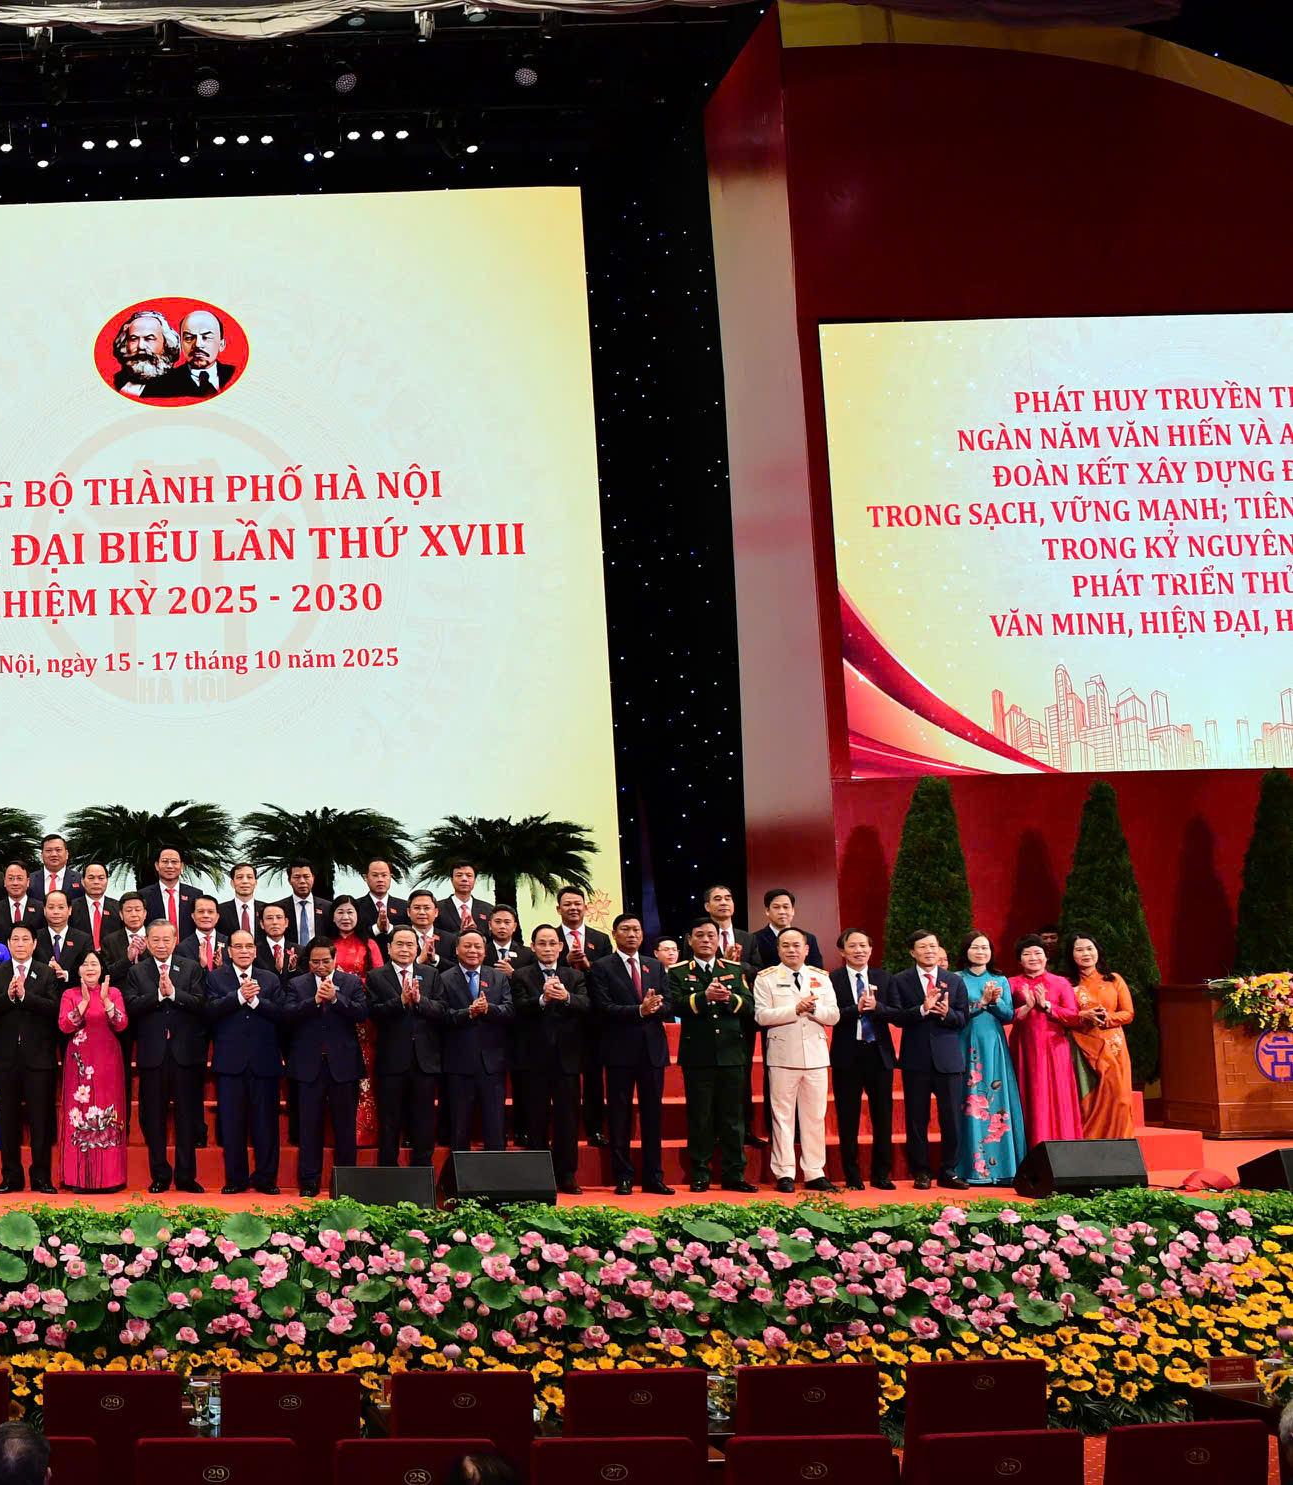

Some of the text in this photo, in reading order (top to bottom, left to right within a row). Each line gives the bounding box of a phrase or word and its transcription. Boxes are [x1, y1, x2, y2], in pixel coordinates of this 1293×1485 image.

[1015, 386, 1084, 413] PHÁT
[1094, 390, 1147, 411] HUY
[1155, 381, 1261, 410] TRUYỀN
[958, 423, 1031, 451] NGÀN
[1041, 423, 1099, 448] NĂM
[1108, 422, 1159, 447] VĂN
[1168, 418, 1231, 446] HIẾN
[1240, 418, 1272, 444] VÀ
[994, 459, 1068, 487] ĐOÀN
[1078, 457, 1128, 485] KẾT
[1138, 457, 1186, 484] XÂY
[1196, 461, 1274, 488] DỰNG
[25, 472, 73, 514] BỘ
[84, 469, 213, 505] THÀNH
[227, 465, 302, 502] PHỐ
[315, 465, 365, 500] HÀ
[378, 464, 441, 505] NỘI
[866, 491, 1293, 530] TRONG SẠCH, VỮNG MẠNH; TIÊN
[12, 533, 84, 574] ĐẠI
[100, 520, 197, 564] BIỂU
[213, 518, 295, 561] LẦN
[309, 517, 408, 559] THỨ
[421, 523, 525, 557] XVIII
[1042, 529, 1293, 560] TRONG KỶ NGUYÊN
[110, 579, 157, 615] KỲ
[168, 585, 257, 614] 2025
[292, 583, 382, 612] 2030
[1073, 569, 1144, 597] PHÁT
[1152, 568, 1234, 595] TRIỂN
[990, 609, 1042, 637] VĂN
[1052, 612, 1133, 637] MINH,
[1141, 606, 1205, 638] HIỆN
[1215, 610, 1268, 637] ĐẠI,
[0, 654, 40, 678] Nội,
[48, 653, 97, 677] ngày
[107, 653, 130, 671] 15
[154, 652, 177, 670] 17
[186, 651, 248, 675] tháng
[257, 650, 281, 669] 10
[289, 650, 335, 668] năm
[343, 648, 398, 667] 2025
[105, 1397, 120, 1408] 29
[283, 1398, 298, 1407] 28
[457, 1396, 471, 1405] 27
[207, 1468, 225, 1480] 29
[409, 1472, 427, 1483] 28
[606, 1467, 622, 1477] 27
